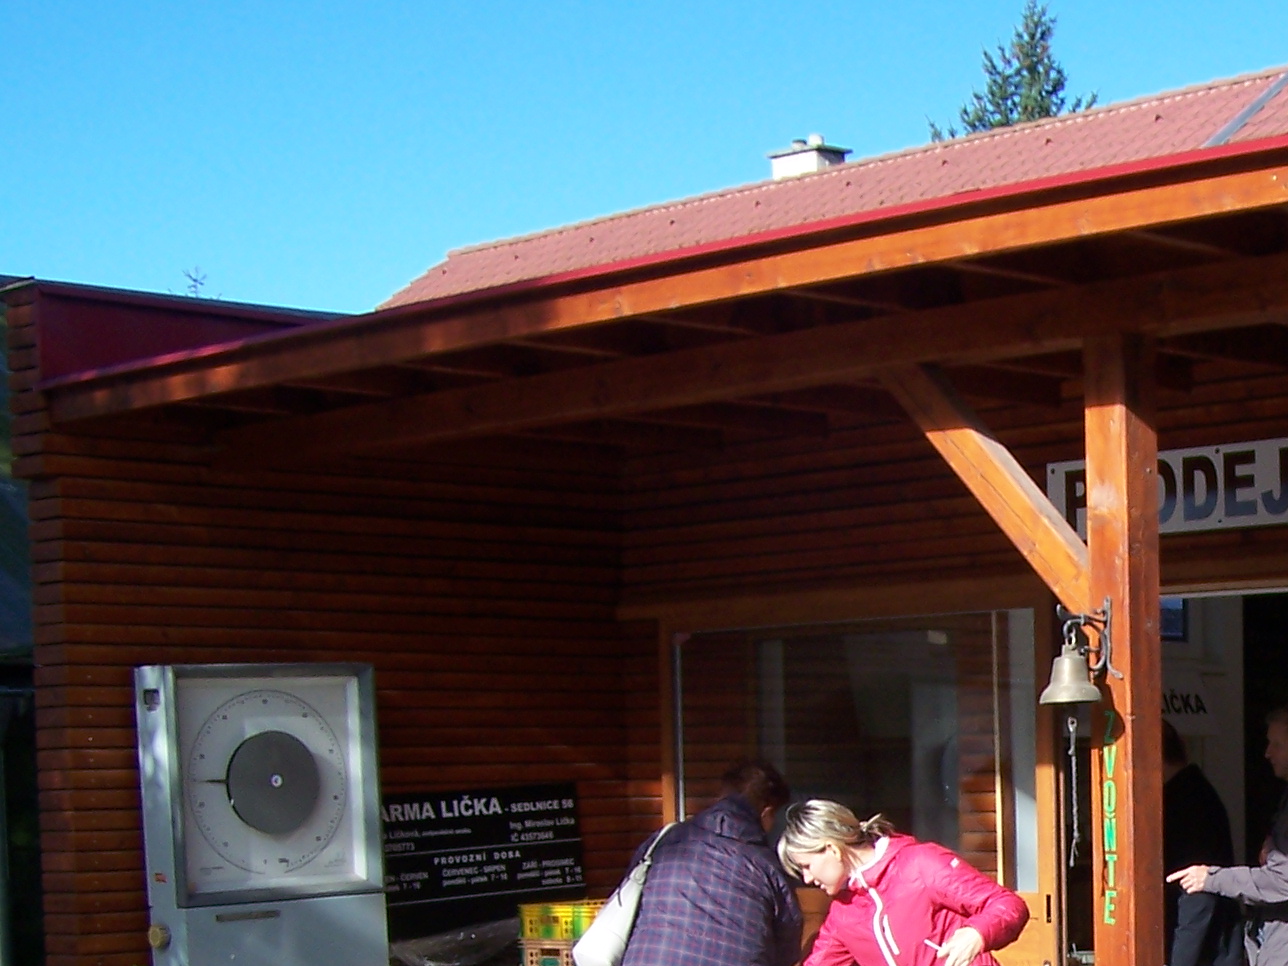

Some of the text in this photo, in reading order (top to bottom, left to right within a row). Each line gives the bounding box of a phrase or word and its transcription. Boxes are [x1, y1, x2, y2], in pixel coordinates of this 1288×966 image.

[1161, 689, 1207, 714] IČKA
[381, 802, 436, 823] ARMA
[440, 795, 503, 818] LIČKA
[510, 800, 560, 813] SEDLNICE
[434, 850, 521, 865] PROVOZNÍ DOBA
